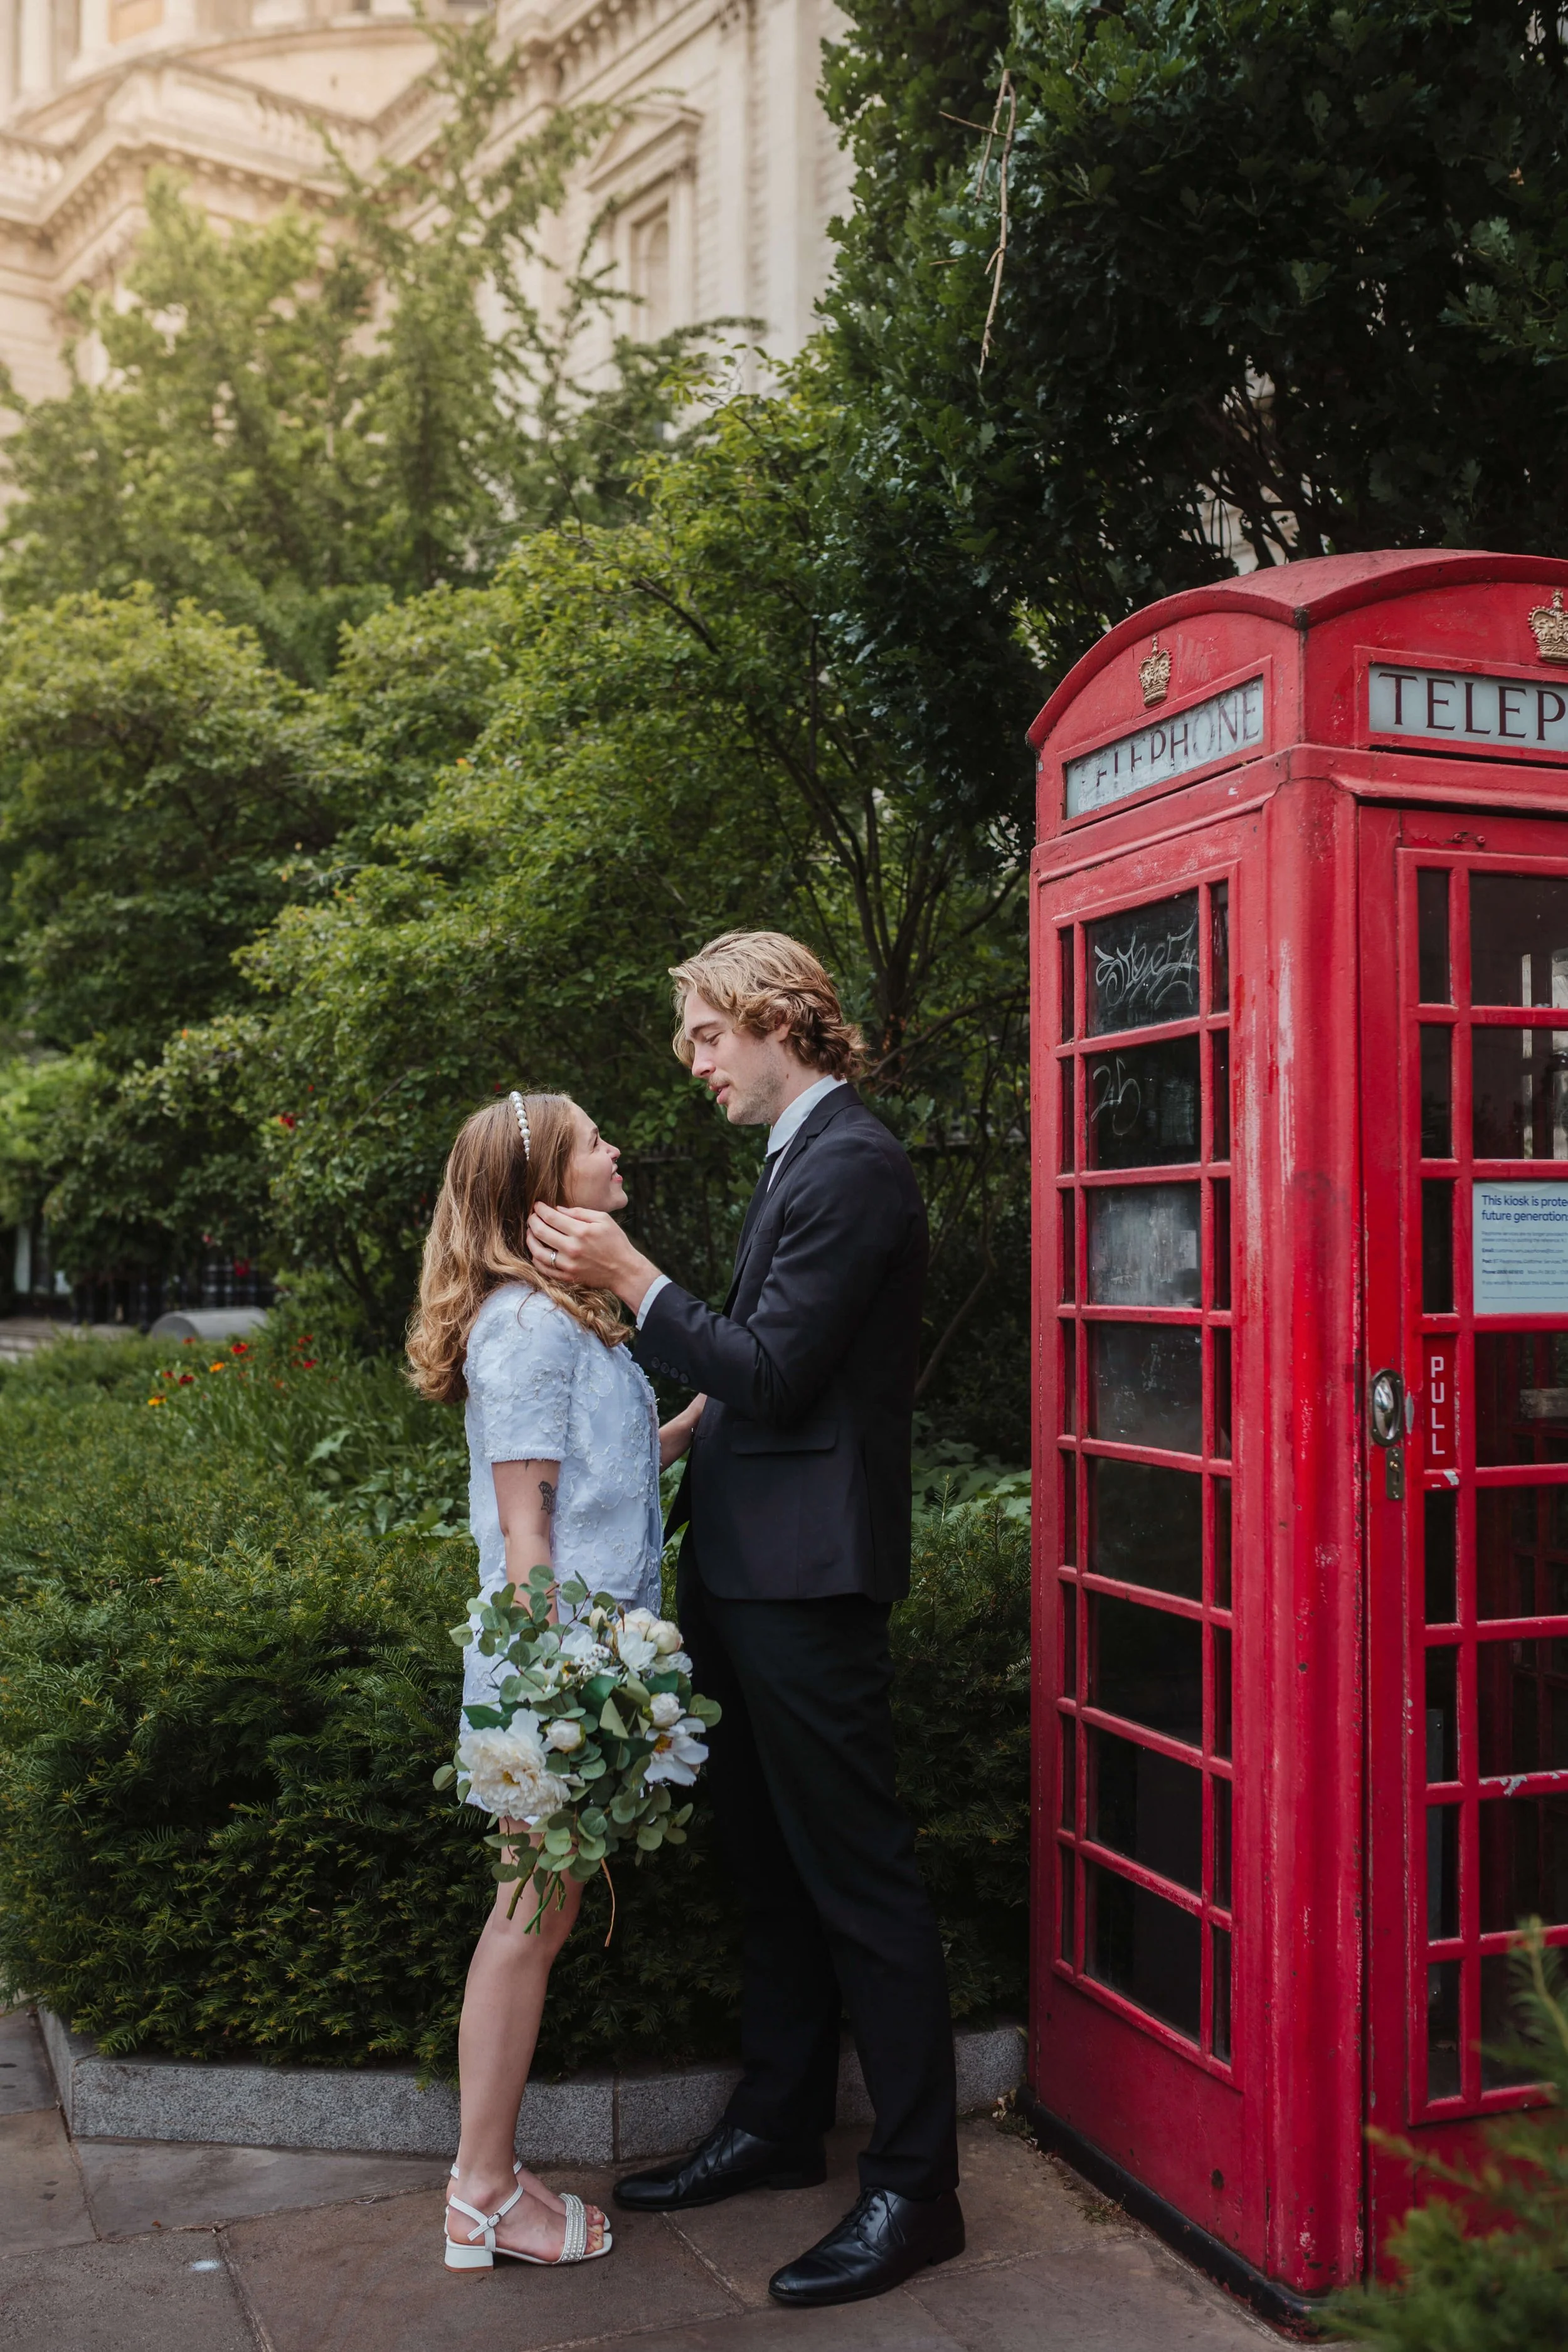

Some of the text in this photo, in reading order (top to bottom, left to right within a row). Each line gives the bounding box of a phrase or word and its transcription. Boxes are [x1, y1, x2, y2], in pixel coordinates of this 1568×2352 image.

[1378, 672, 1567, 741] TELEP
[1481, 1195, 1568, 1209] This kiosk is prote
[1481, 1210, 1511, 1221] future
[1431, 1356, 1445, 1454] PULL
